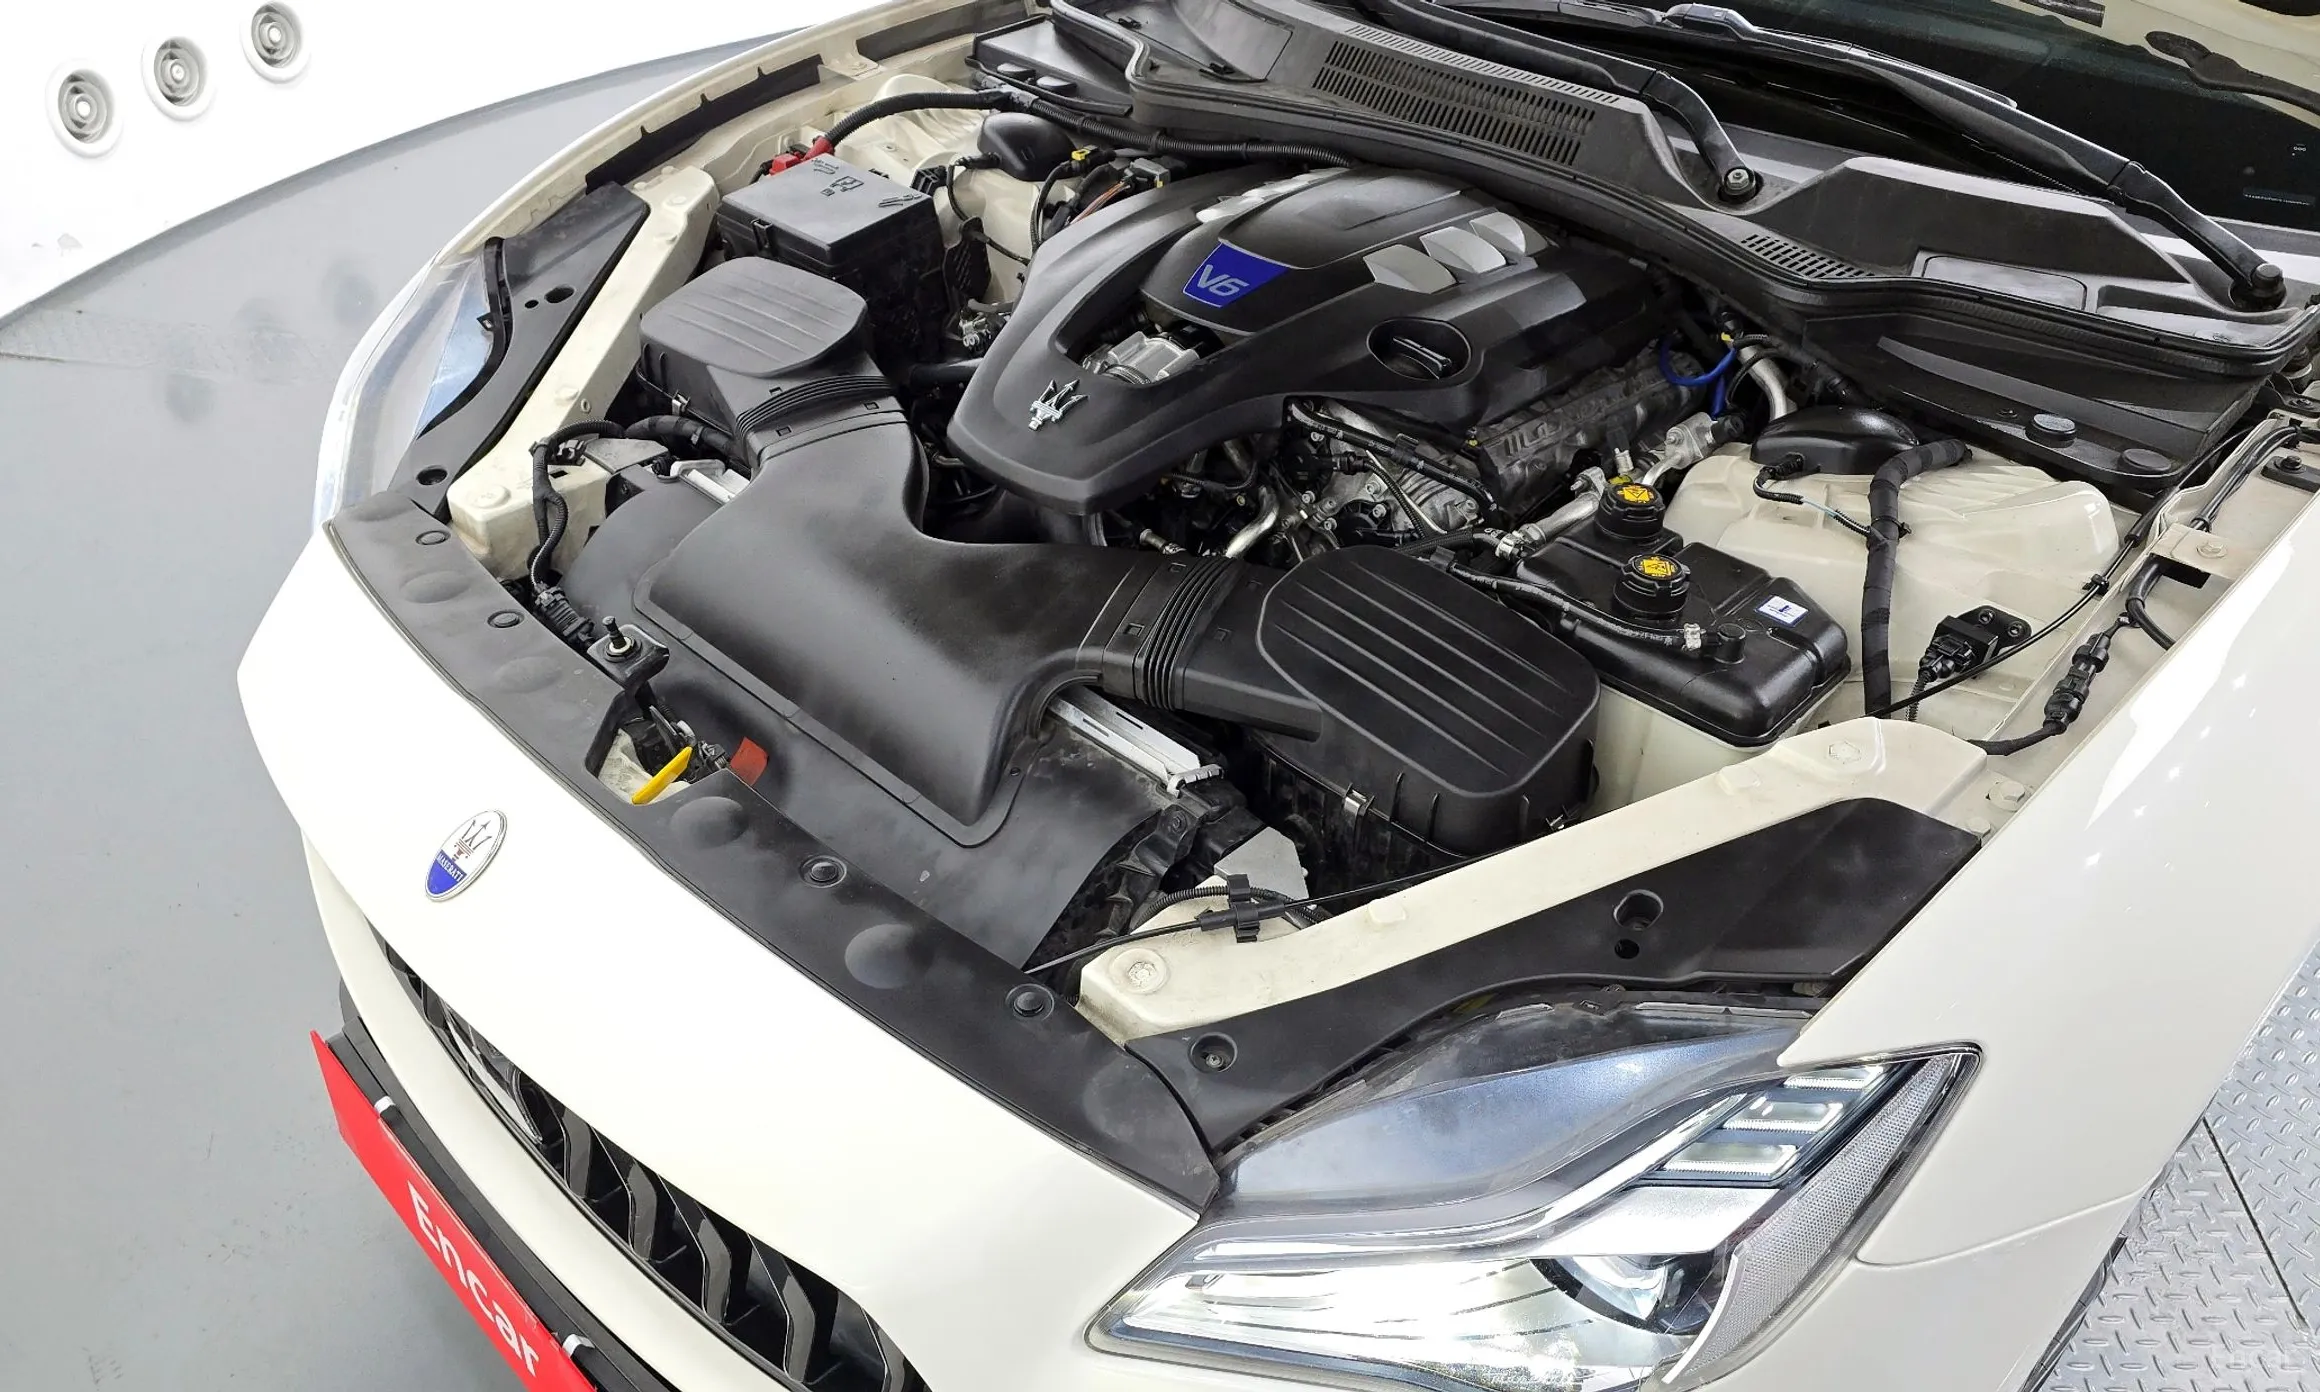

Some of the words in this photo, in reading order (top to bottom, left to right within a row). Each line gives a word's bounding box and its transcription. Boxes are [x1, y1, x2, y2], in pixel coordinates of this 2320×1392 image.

[1197, 264, 1249, 296] V6
[436, 853, 464, 882] MASERATI
[407, 1180, 540, 1377] Encar
